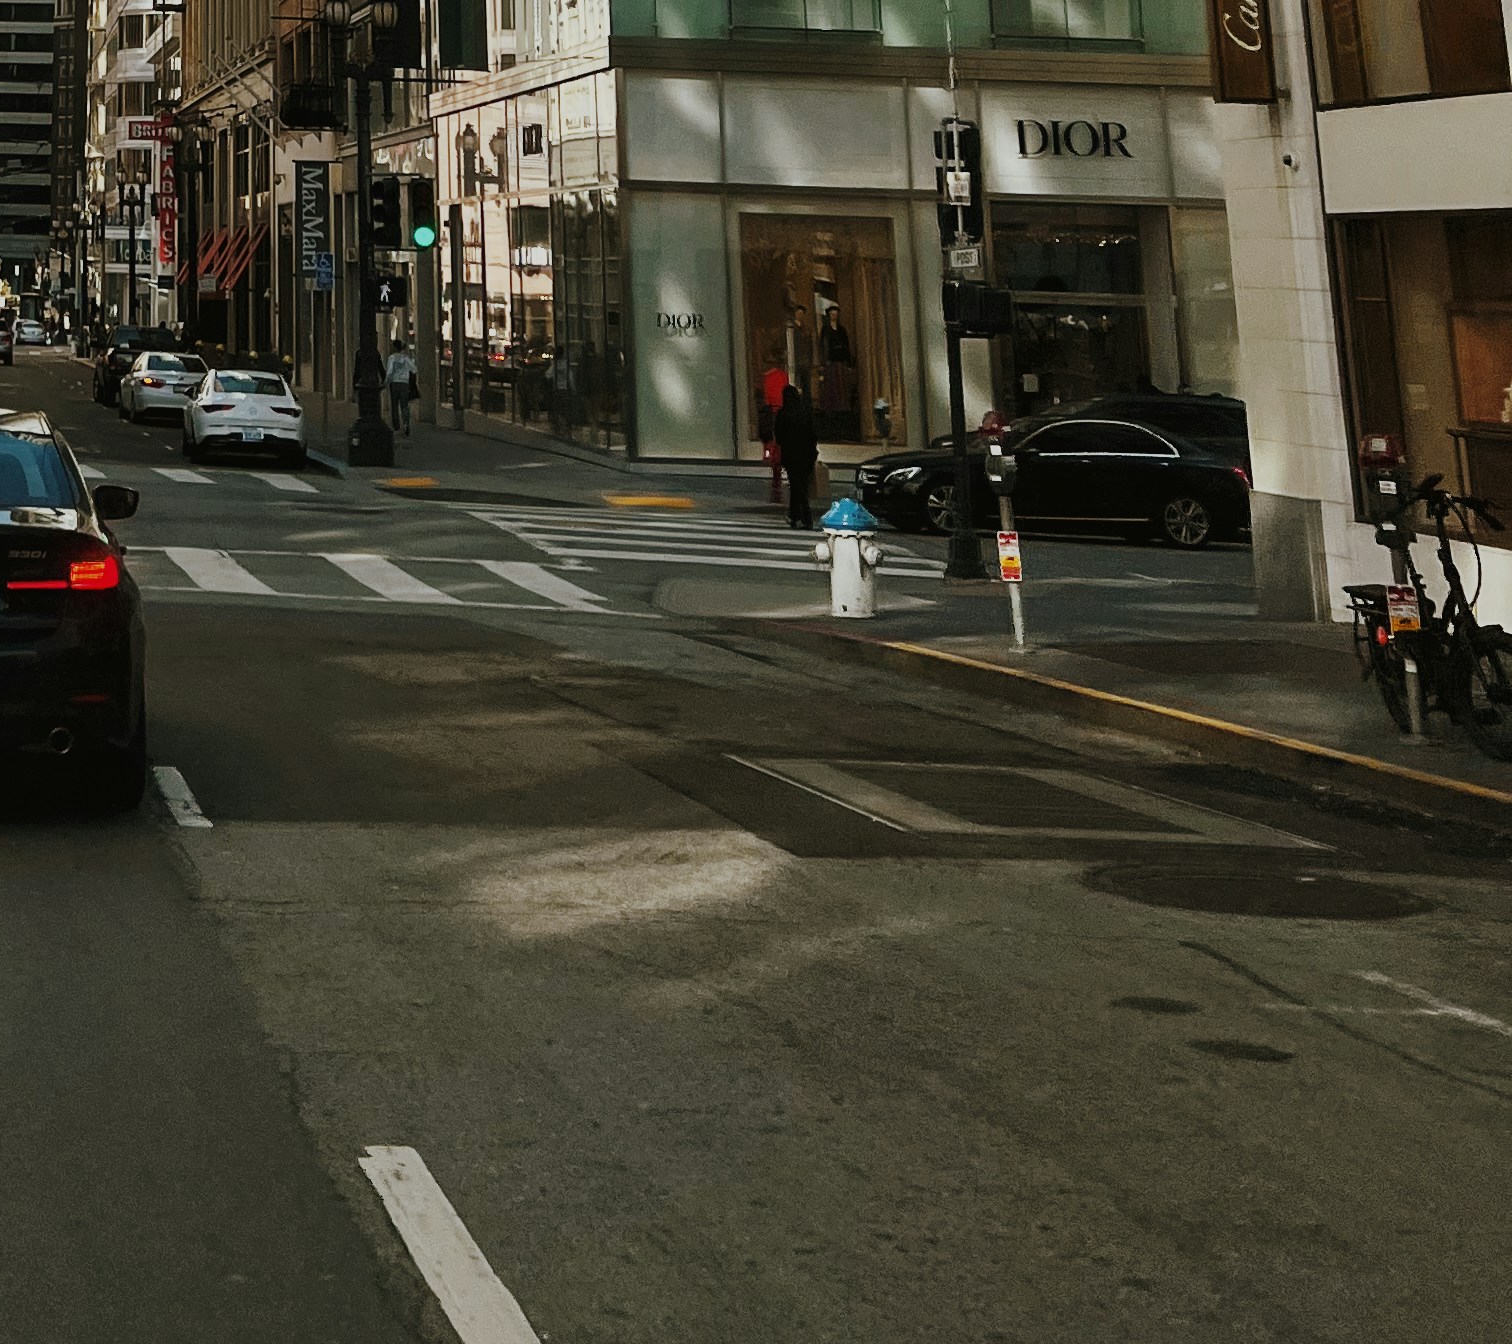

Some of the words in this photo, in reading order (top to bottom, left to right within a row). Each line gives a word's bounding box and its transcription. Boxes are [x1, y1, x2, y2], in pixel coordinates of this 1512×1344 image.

[1016, 119, 1135, 159] DIOR
[162, 145, 175, 259] FABRICS
[302, 166, 324, 271] MaxMara
[657, 312, 705, 330] DIOR
